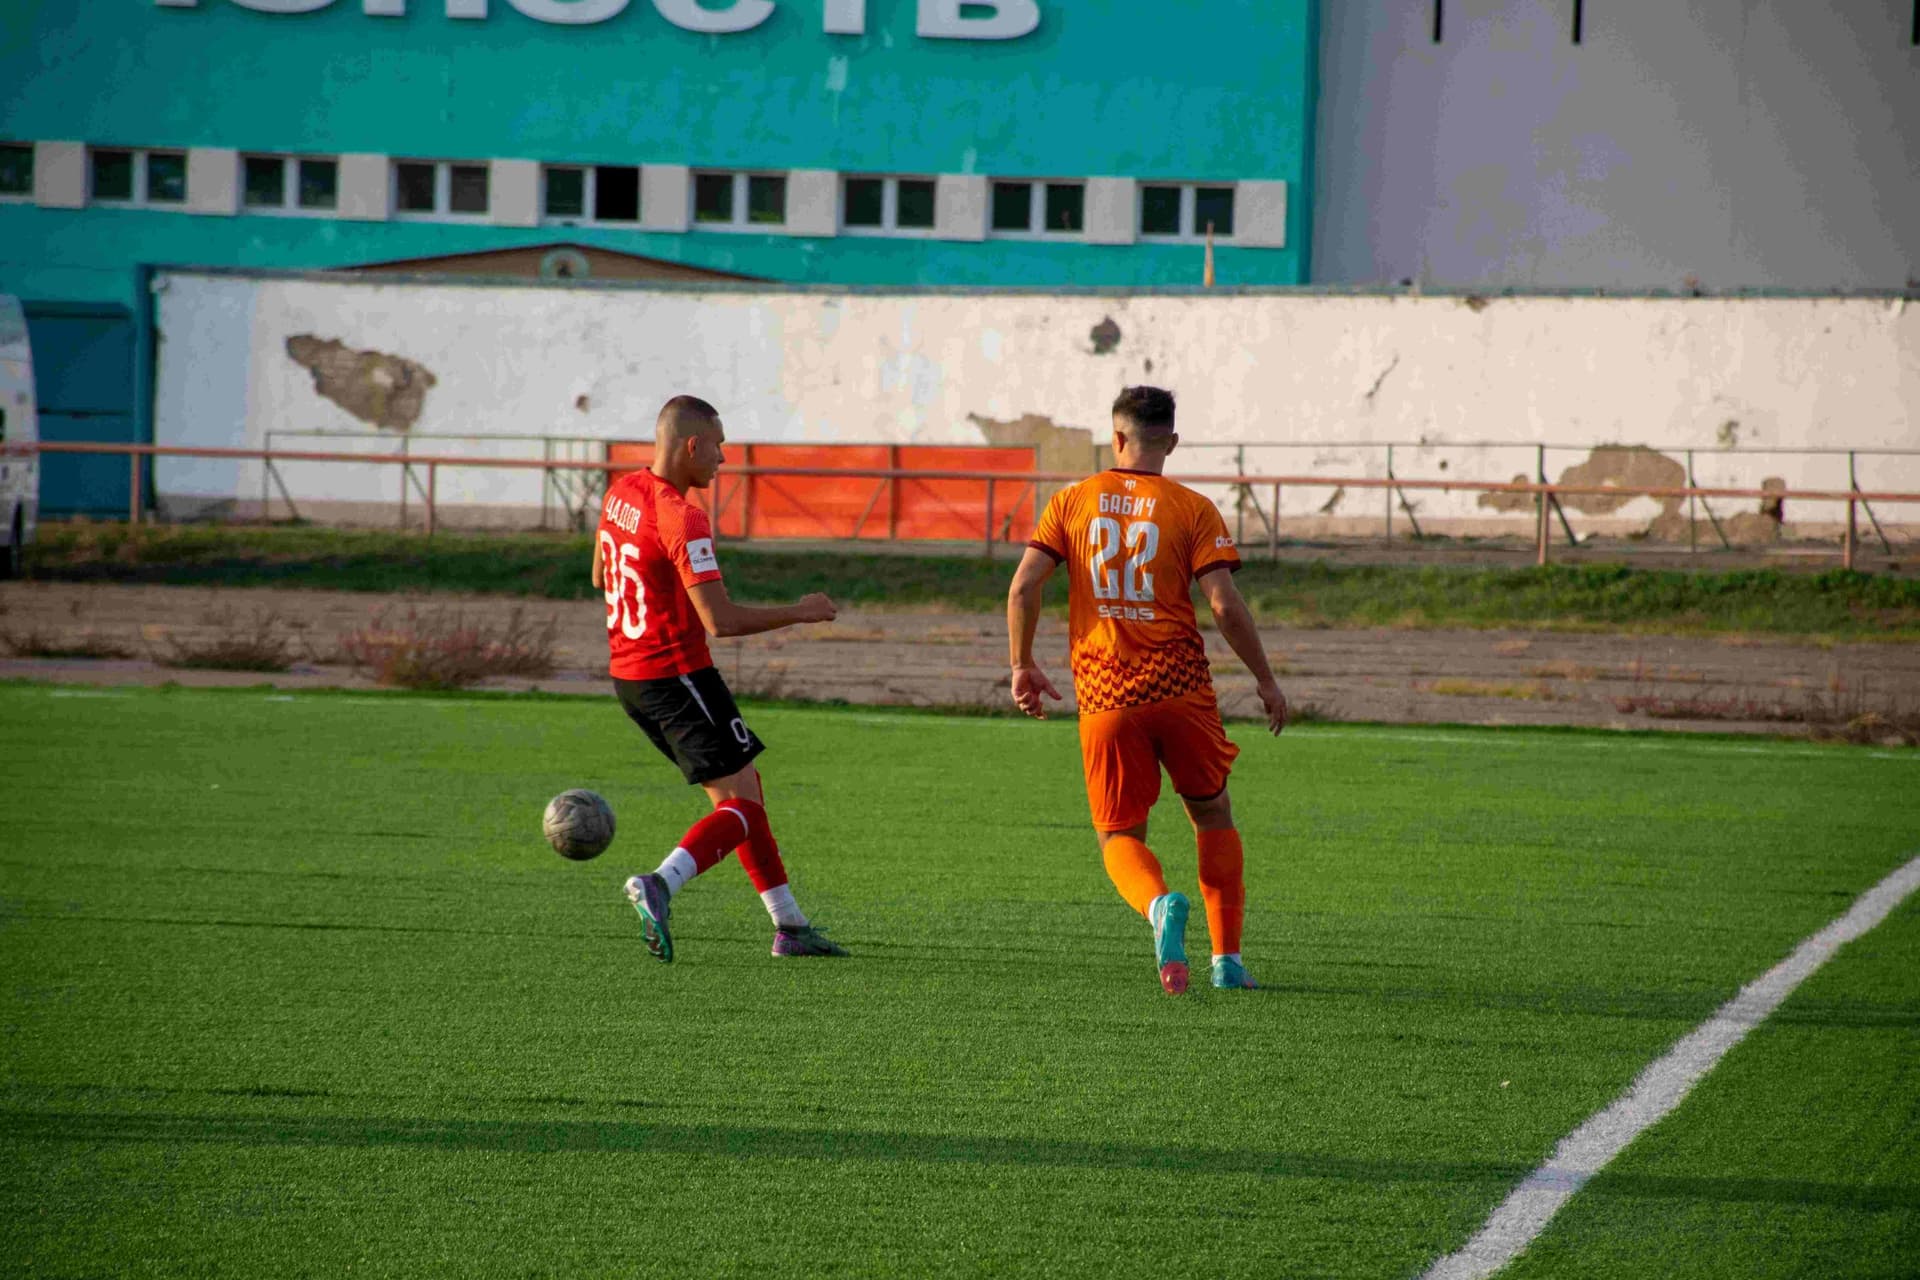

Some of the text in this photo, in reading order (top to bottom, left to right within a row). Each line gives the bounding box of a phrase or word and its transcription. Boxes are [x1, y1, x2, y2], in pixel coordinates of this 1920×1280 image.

[605, 495, 641, 535] ЧАДОВ
[1099, 493, 1157, 518] БАБИЧ
[599, 529, 648, 640] 96
[1088, 516, 1160, 603] 22
